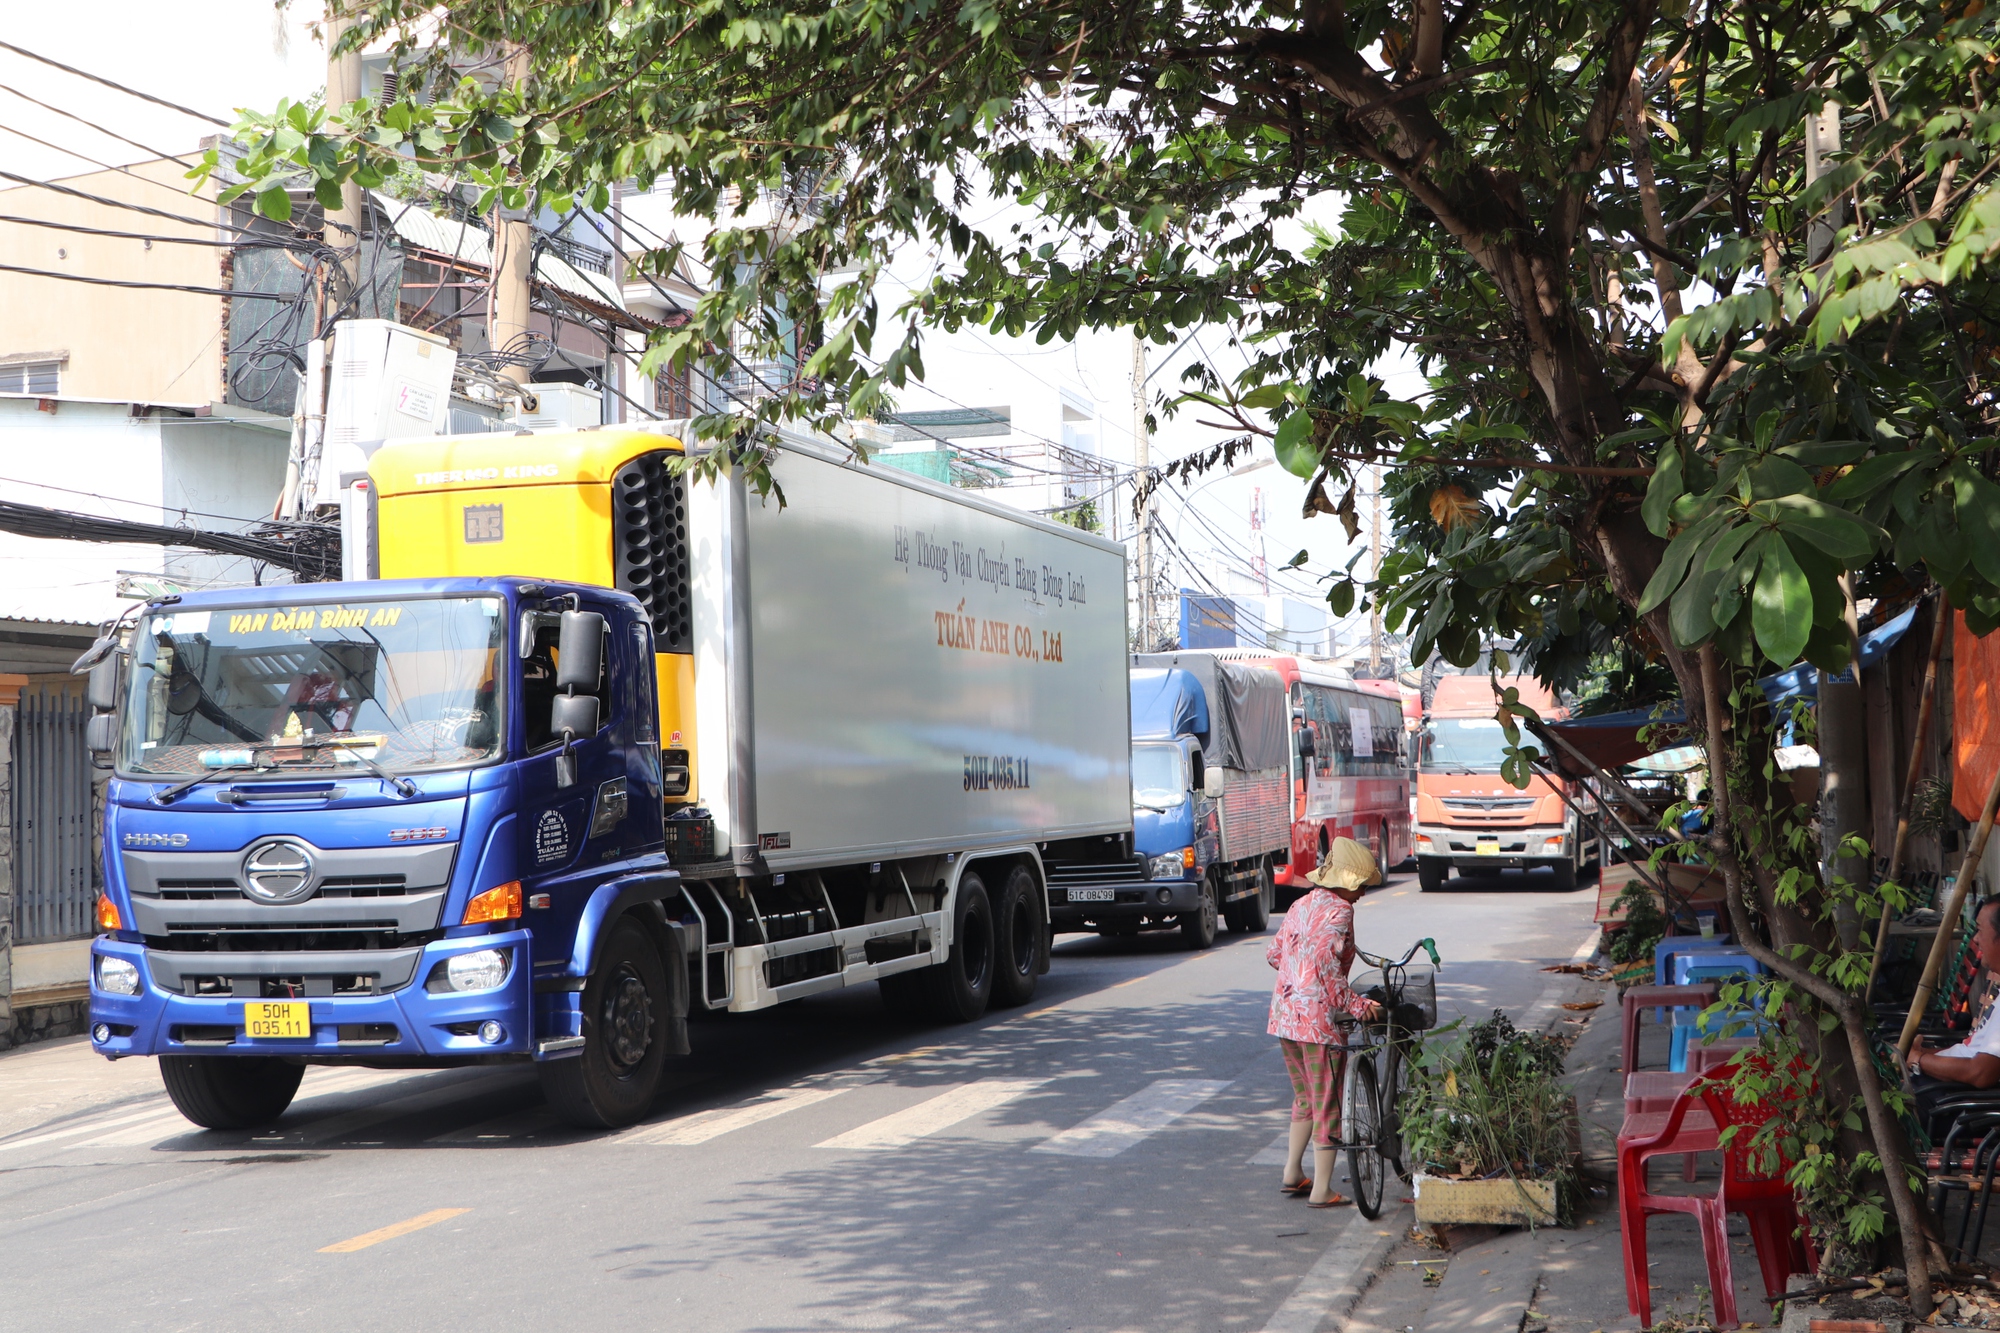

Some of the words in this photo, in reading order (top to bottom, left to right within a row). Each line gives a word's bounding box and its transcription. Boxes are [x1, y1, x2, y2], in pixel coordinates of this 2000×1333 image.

[414, 467, 499, 485] THERMO
[503, 463, 559, 479] KING
[894, 525, 909, 574] Hệ
[915, 524, 948, 583] Thống
[952, 540, 972, 586] Vận
[977, 540, 1010, 594] Chuyển
[1015, 556, 1037, 601] Hàng
[1042, 565, 1063, 608] Đông
[1067, 571, 1086, 610] Lạnh
[229, 613, 269, 635] VẠN
[270, 606, 316, 633] DẶM
[320, 604, 369, 629] BÌNH
[370, 607, 402, 627] AN
[934, 596, 976, 650] TUẤN
[980, 619, 1010, 655] ANH
[1014, 624, 1039, 663] CO.,
[1042, 629, 1063, 663] Ltd
[963, 754, 1030, 792] 50H-035.11
[124, 833, 190, 847] HINO
[388, 826, 449, 842] 500
[555, 843, 568, 852] ANH
[262, 1003, 290, 1019] 50H
[252, 1020, 301, 1035] 035.11
